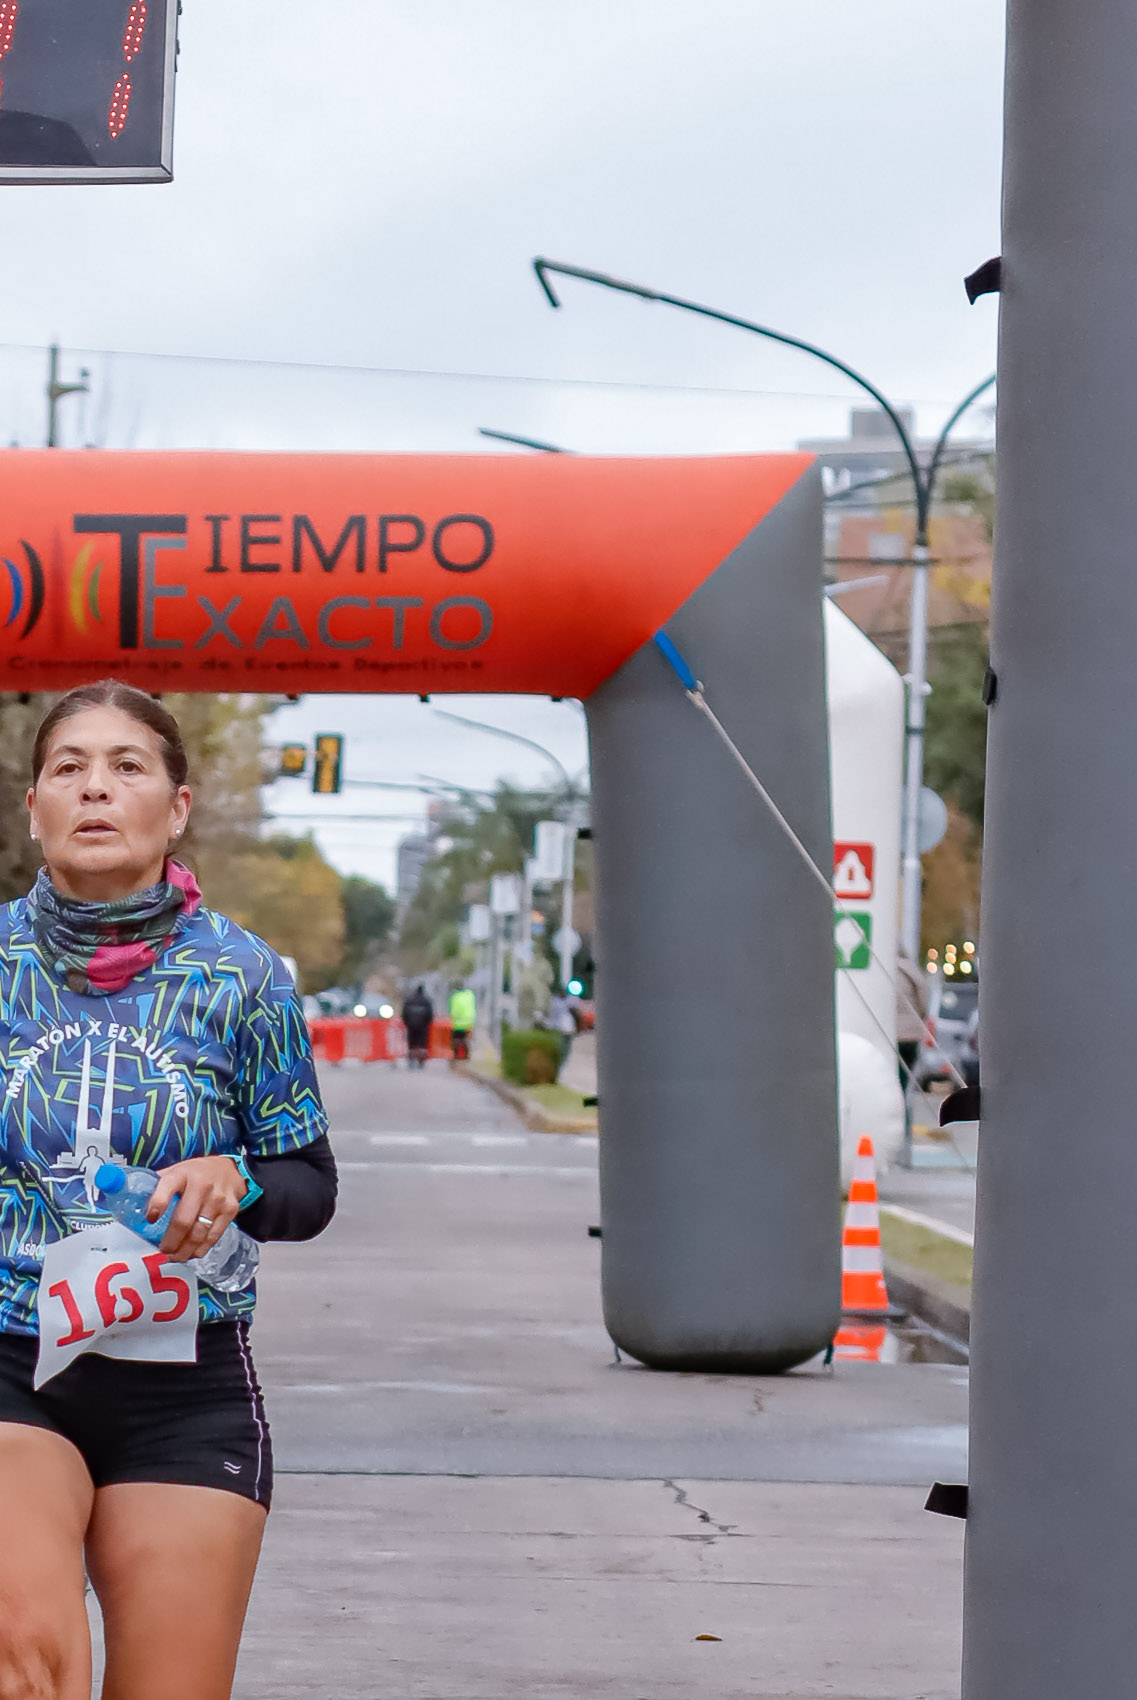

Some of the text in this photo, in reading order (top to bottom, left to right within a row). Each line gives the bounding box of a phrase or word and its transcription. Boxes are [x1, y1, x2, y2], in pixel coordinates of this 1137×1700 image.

[6, 1020, 190, 1119] MARATÓN X EL AUTISMO
[49, 1252, 190, 1347] 165
